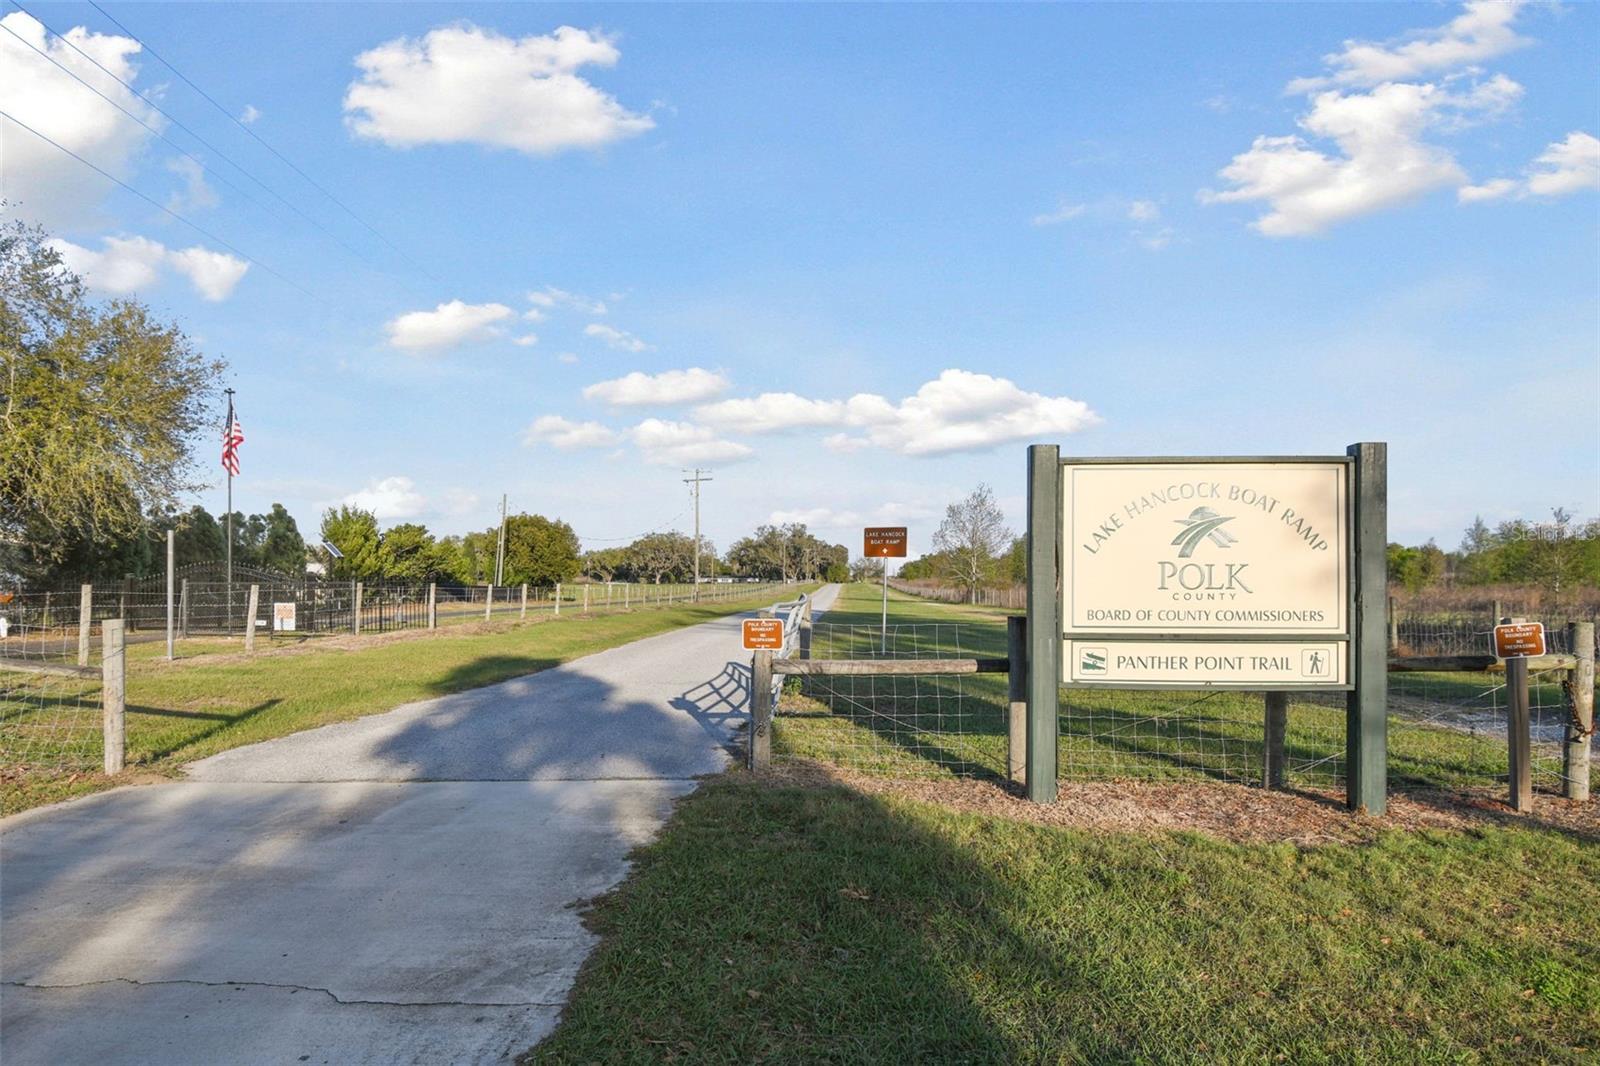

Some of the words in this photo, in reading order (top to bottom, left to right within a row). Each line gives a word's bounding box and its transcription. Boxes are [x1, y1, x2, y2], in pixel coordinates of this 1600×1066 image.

[1083, 513, 1124, 554] LAKE
[1124, 482, 1220, 519] HANCOCK
[1228, 485, 1280, 513] BOAT
[1280, 507, 1328, 551] RAMP
[1157, 561, 1254, 594] POLK
[1172, 593, 1237, 601] COUNTY
[1087, 610, 1131, 622] BOARD
[1136, 610, 1153, 622] OF
[1158, 610, 1211, 622] COUNTY
[1215, 610, 1324, 622] COMMISSIONERS
[1117, 655, 1188, 671] PANTHER
[1194, 655, 1244, 671] POINT
[1249, 656, 1292, 671] TRAIL
